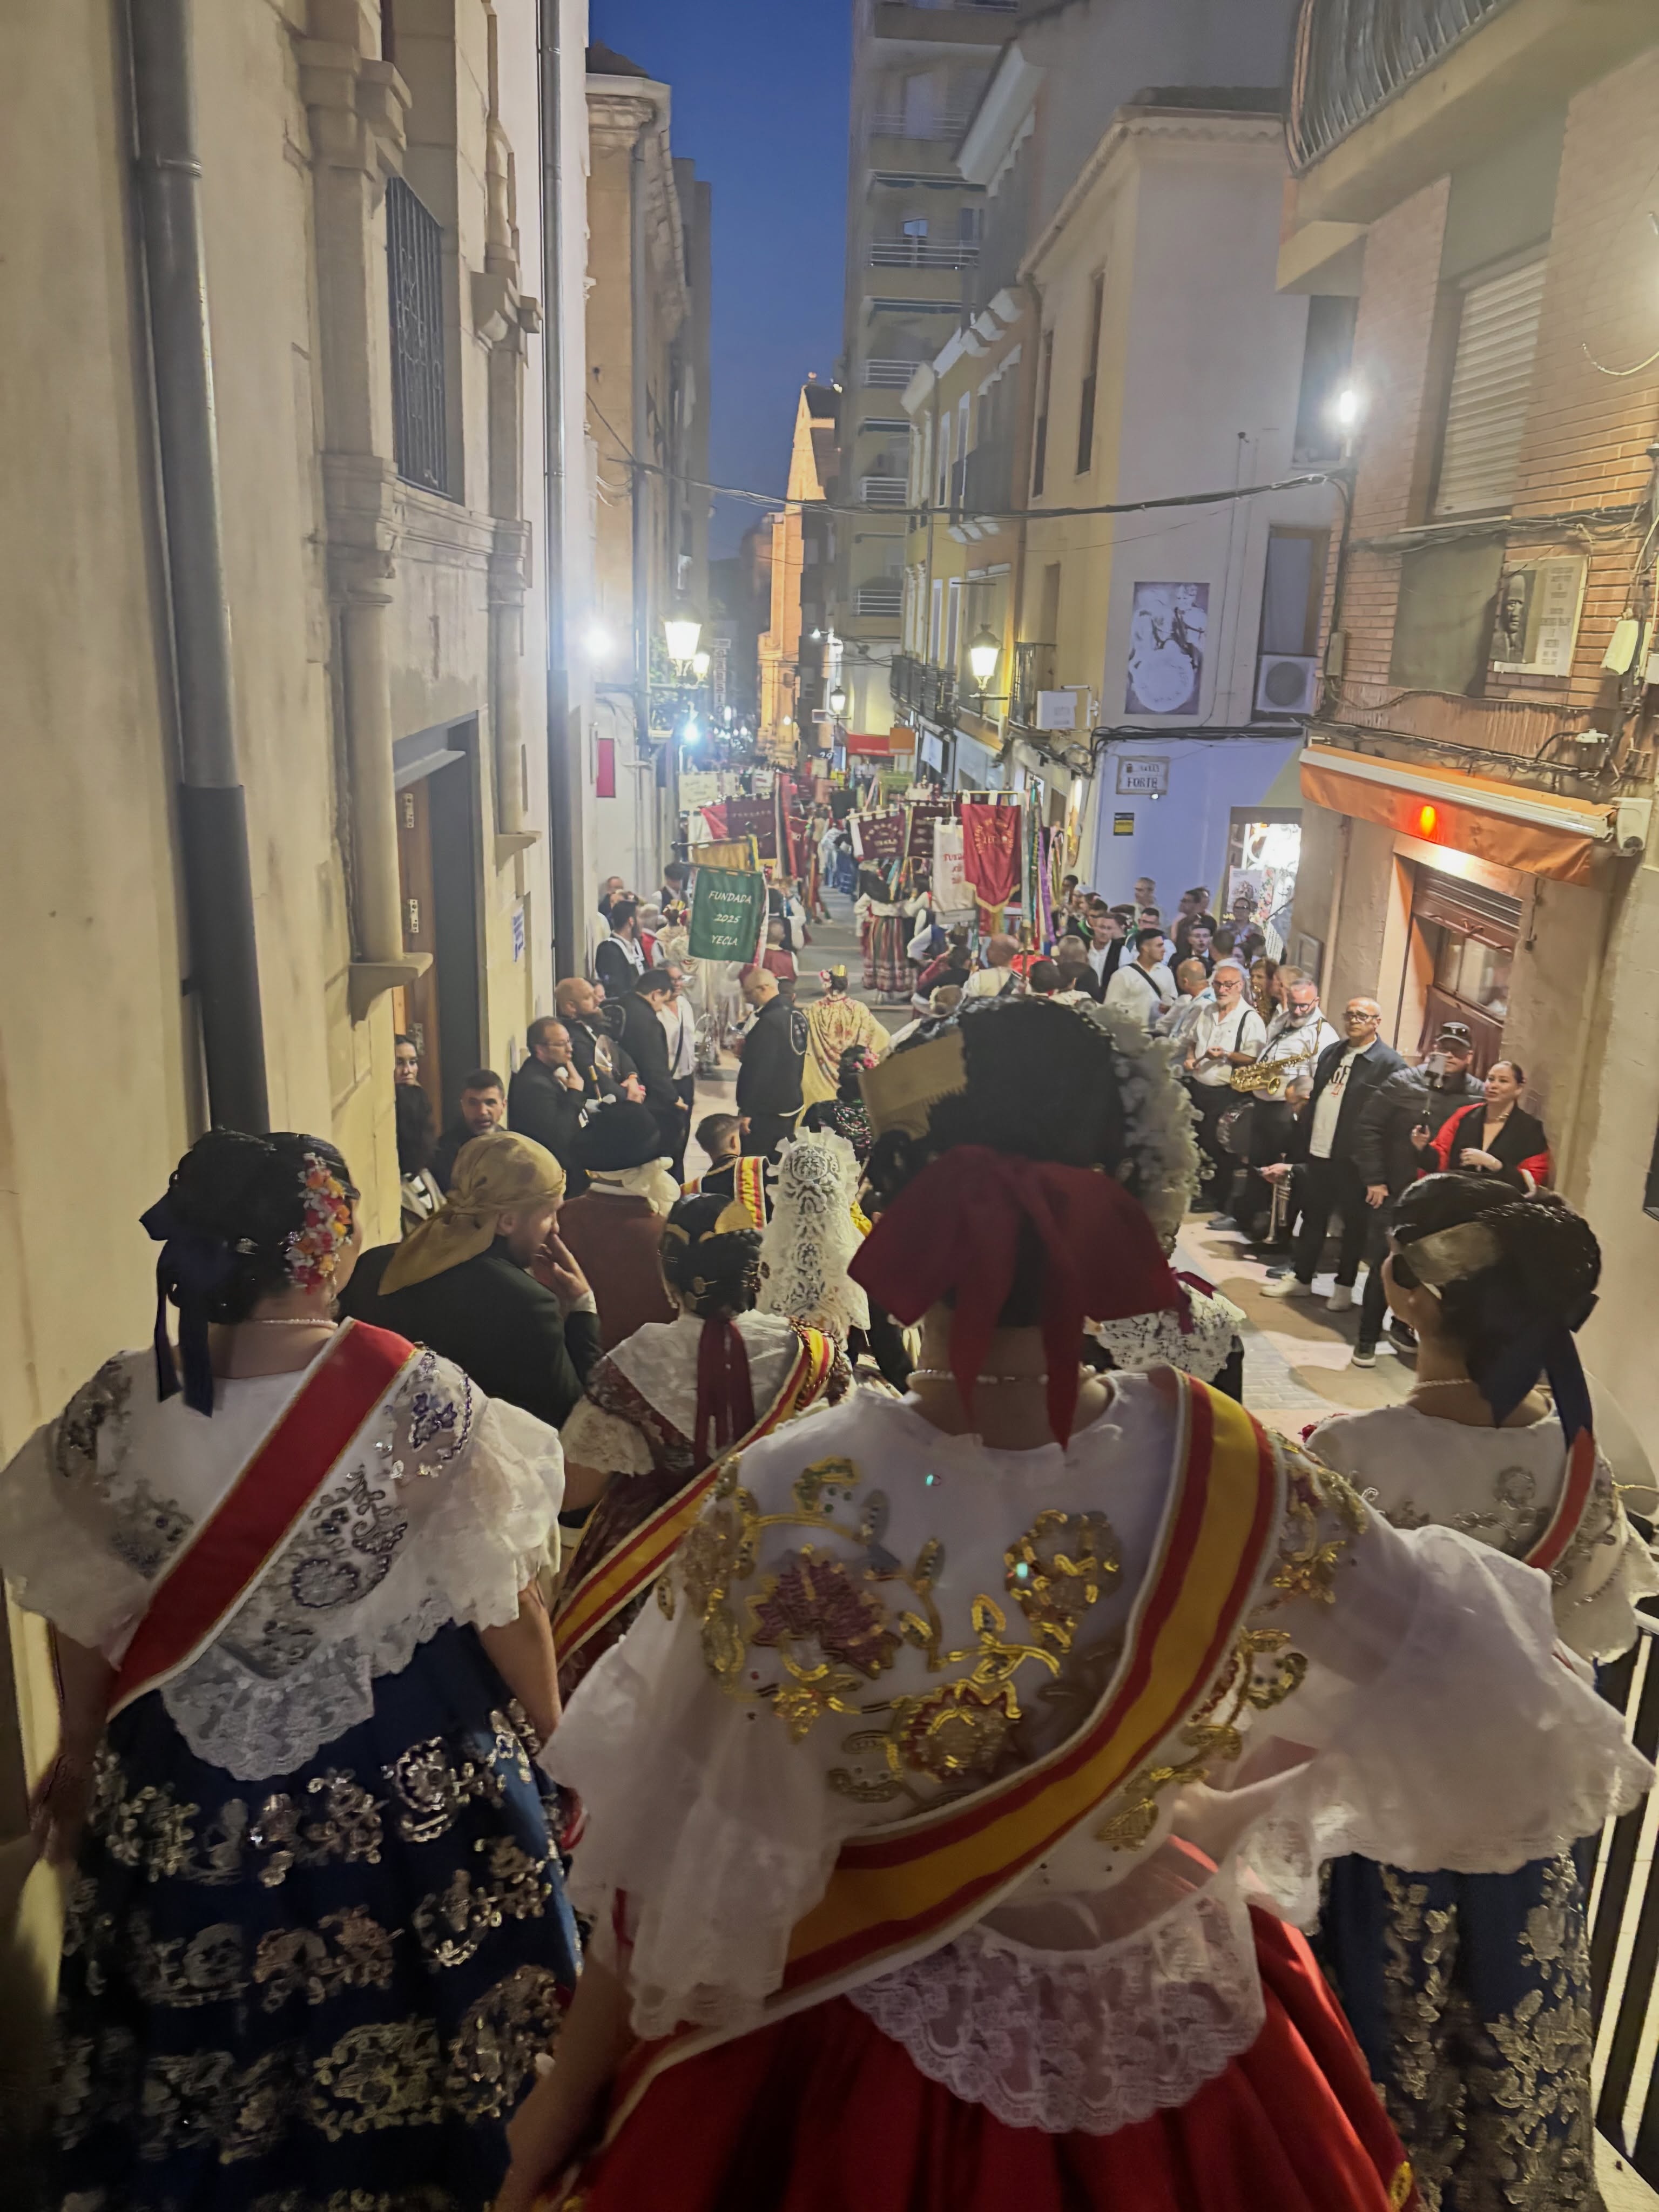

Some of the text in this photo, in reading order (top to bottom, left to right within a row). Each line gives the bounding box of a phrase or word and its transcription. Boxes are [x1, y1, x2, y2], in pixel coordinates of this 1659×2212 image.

[1127, 777, 1158, 788] FORTE
[708, 891, 752, 905] FUNDADA
[713, 913, 742, 923] 2025
[711, 935, 738, 946] YECLA
